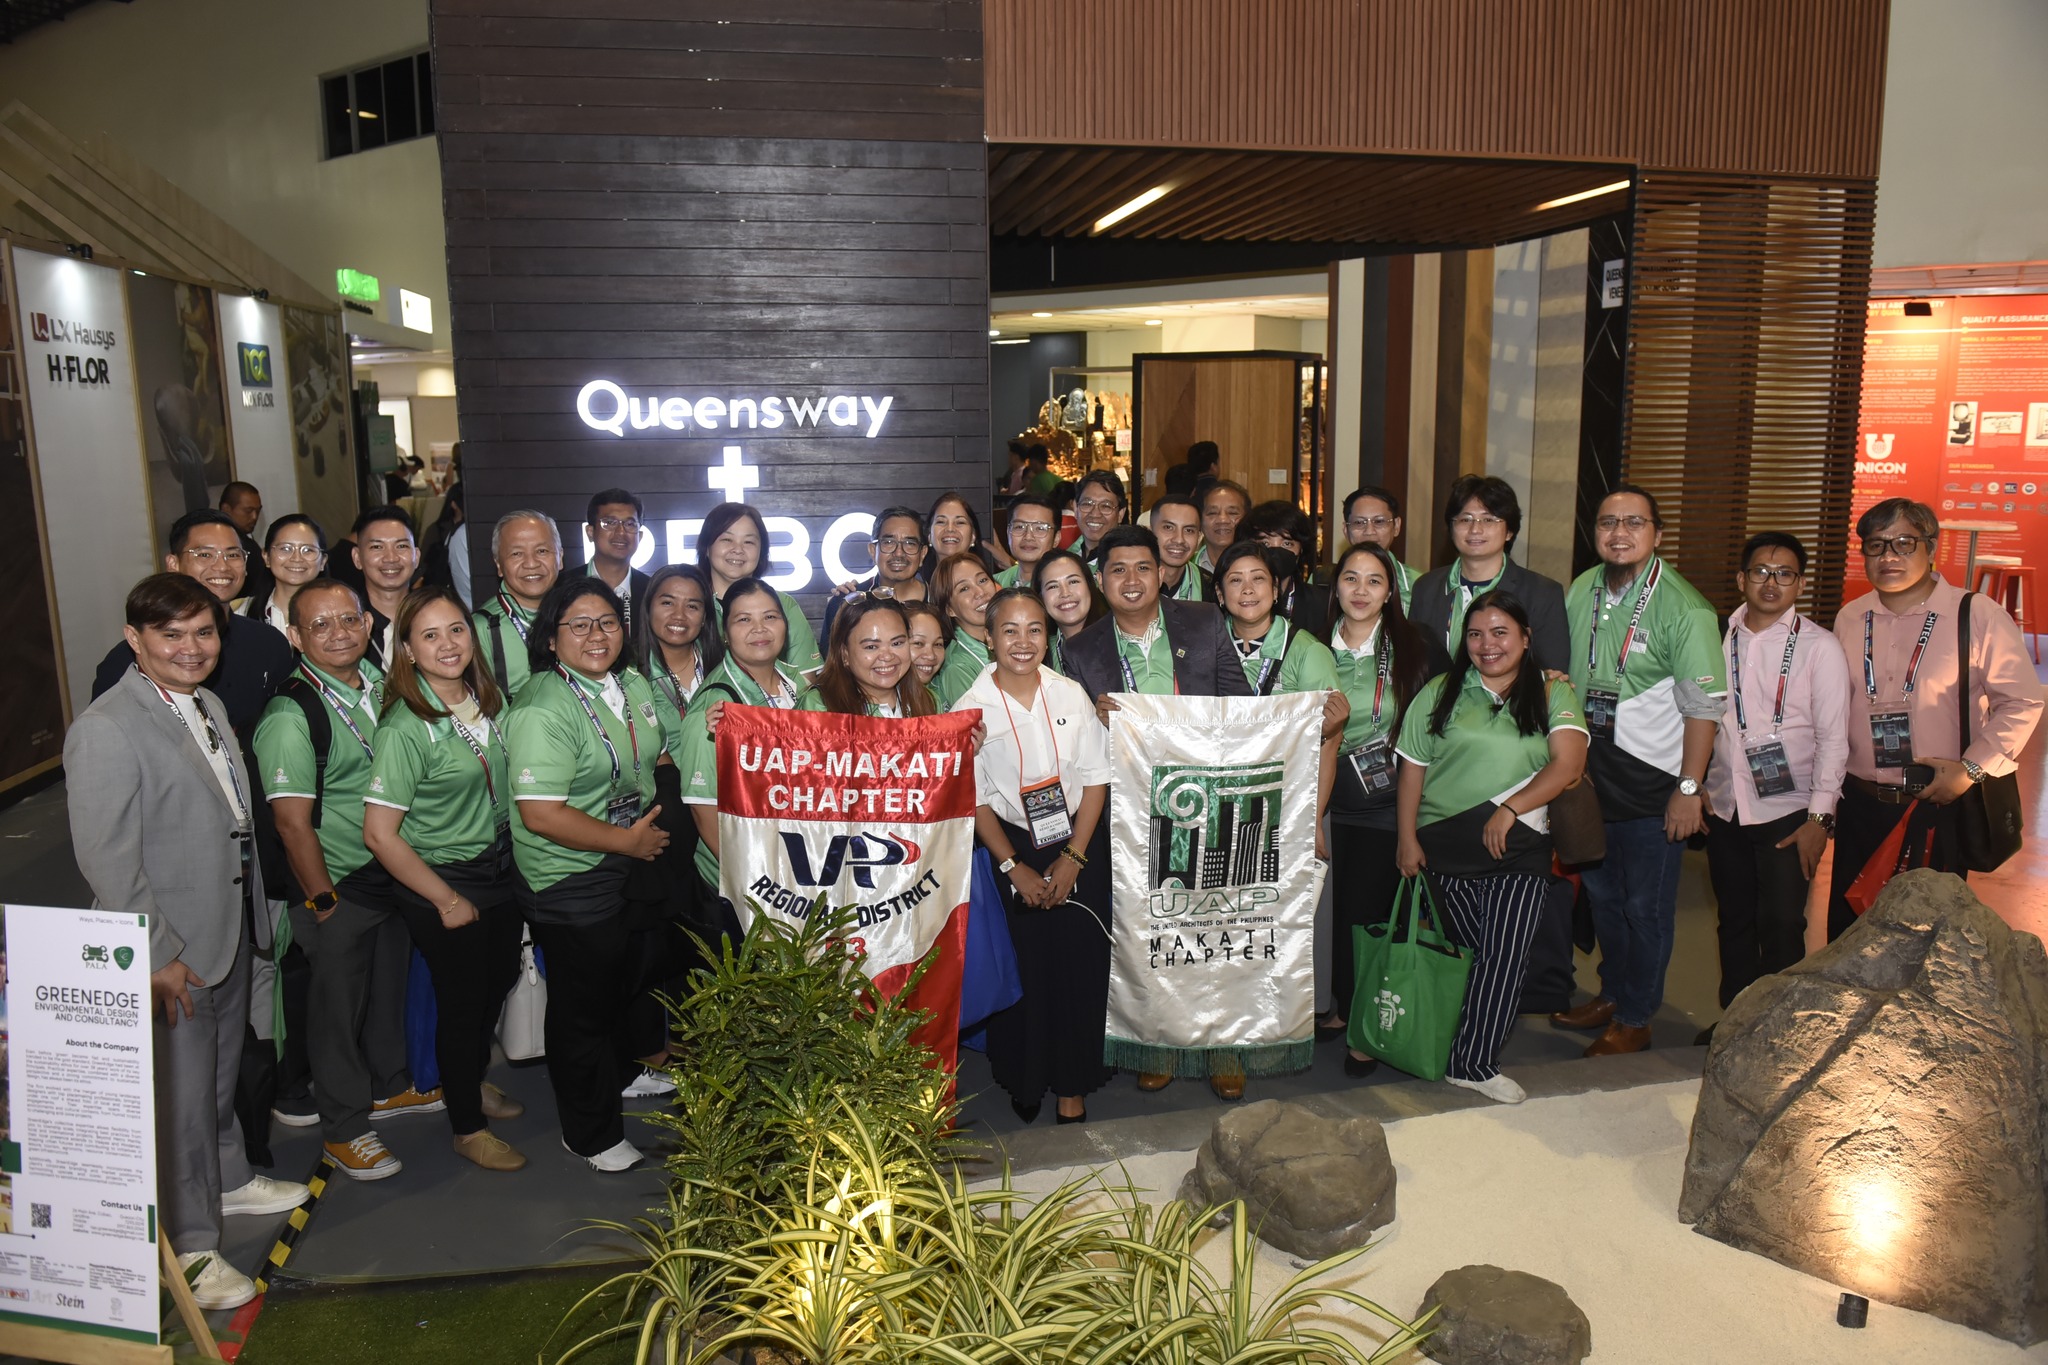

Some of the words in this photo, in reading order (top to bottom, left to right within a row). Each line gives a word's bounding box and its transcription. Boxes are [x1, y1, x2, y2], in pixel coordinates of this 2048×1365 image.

[1961, 316, 1997, 325] QUALITY
[1998, 314, 2048, 323] ASSURANCE
[50, 319, 71, 343] LX
[72, 321, 116, 350] Hausys
[576, 379, 894, 438] Queensway
[623, 591, 632, 625] CHITECT
[1629, 583, 1651, 628] ARCHITECT
[1918, 611, 1938, 646] CHITECT
[1781, 632, 1797, 676] ARCHITECT
[448, 713, 483, 757] RCHITECT
[739, 744, 962, 778] UAP-MAKATI
[768, 784, 926, 815] CHAPTER
[1040, 830, 1070, 844] EXHIBITOR
[856, 868, 941, 928] DISTRICT
[1149, 886, 1280, 919] UAP
[79, 916, 95, 924] Ways,
[95, 917, 114, 925] Places,
[1179, 920, 1214, 928] ARCHITECTS
[1240, 916, 1274, 924] PHILIPPINES
[1150, 928, 1275, 954] MAKATI
[85, 961, 108, 970] PALA
[1150, 944, 1276, 969] CHAPTER
[35, 985, 140, 1010] GREENEDGE
[34, 1002, 105, 1017] ENVIRONMENTAL
[106, 1008, 138, 1019] DESIGN
[54, 1013, 73, 1023] AND
[74, 1014, 139, 1028] CONSULTANCY
[65, 1038, 88, 1048] About
[89, 1040, 102, 1049] the
[103, 1042, 139, 1053] Company
[100, 1199, 132, 1210] Contact
[132, 1204, 143, 1212] Us
[55, 1292, 85, 1309] Stein
